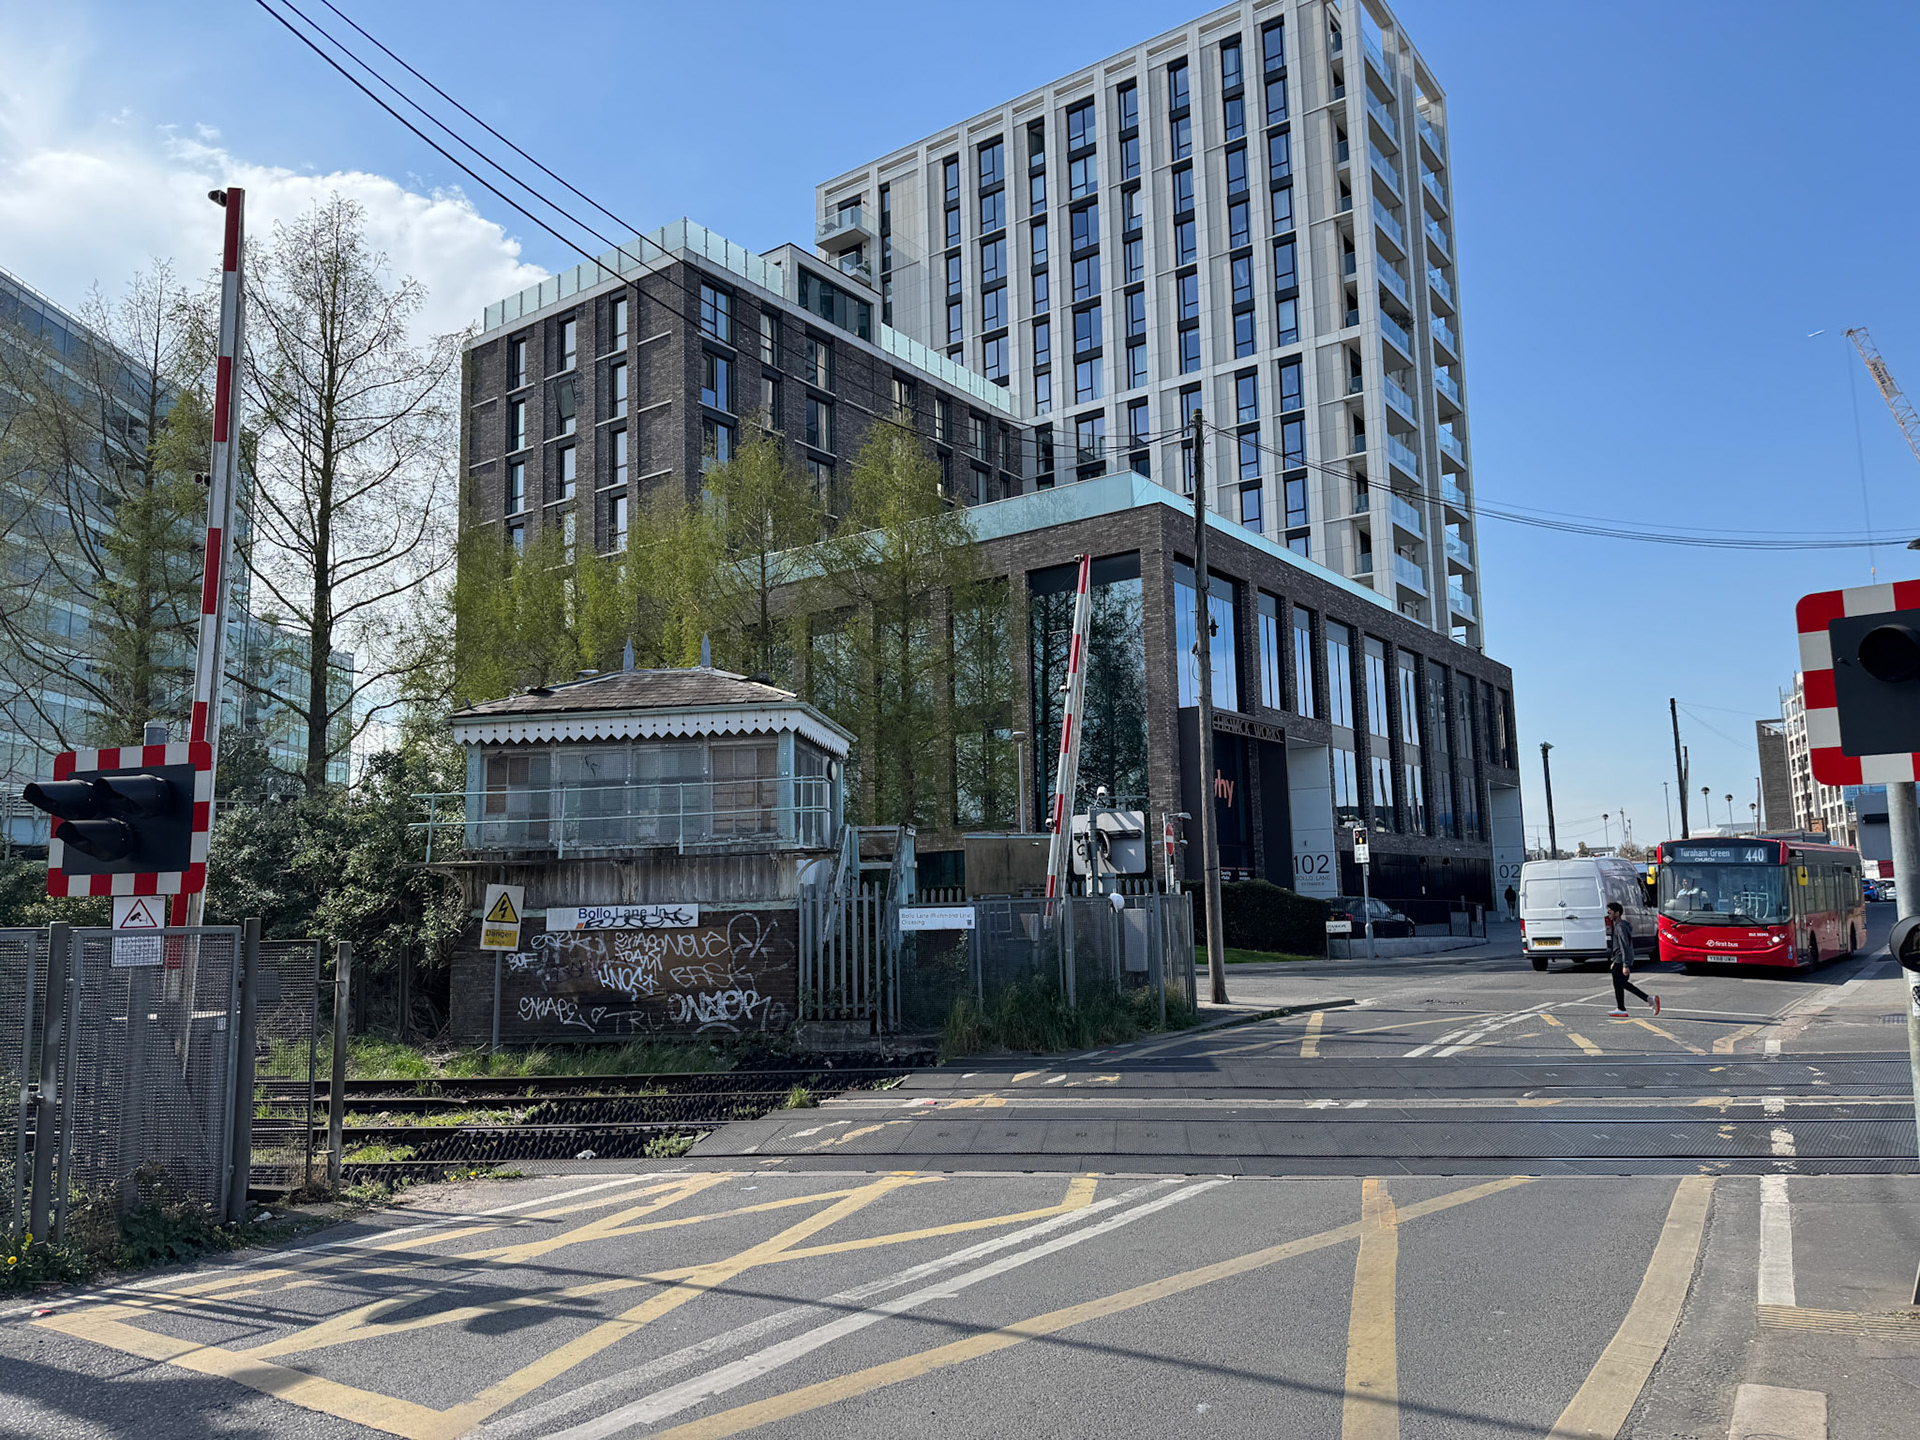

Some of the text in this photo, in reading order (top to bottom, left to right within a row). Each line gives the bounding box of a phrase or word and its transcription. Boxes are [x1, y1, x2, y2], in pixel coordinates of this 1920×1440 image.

[1212, 714, 1283, 741] CHISWICK WORKS
[1680, 848, 1730, 857] Turnham Green
[1745, 848, 1764, 862] 440
[1293, 854, 1330, 875] 102
[578, 905, 666, 920] Bollo Lane Jn
[485, 930, 513, 939] Danger
